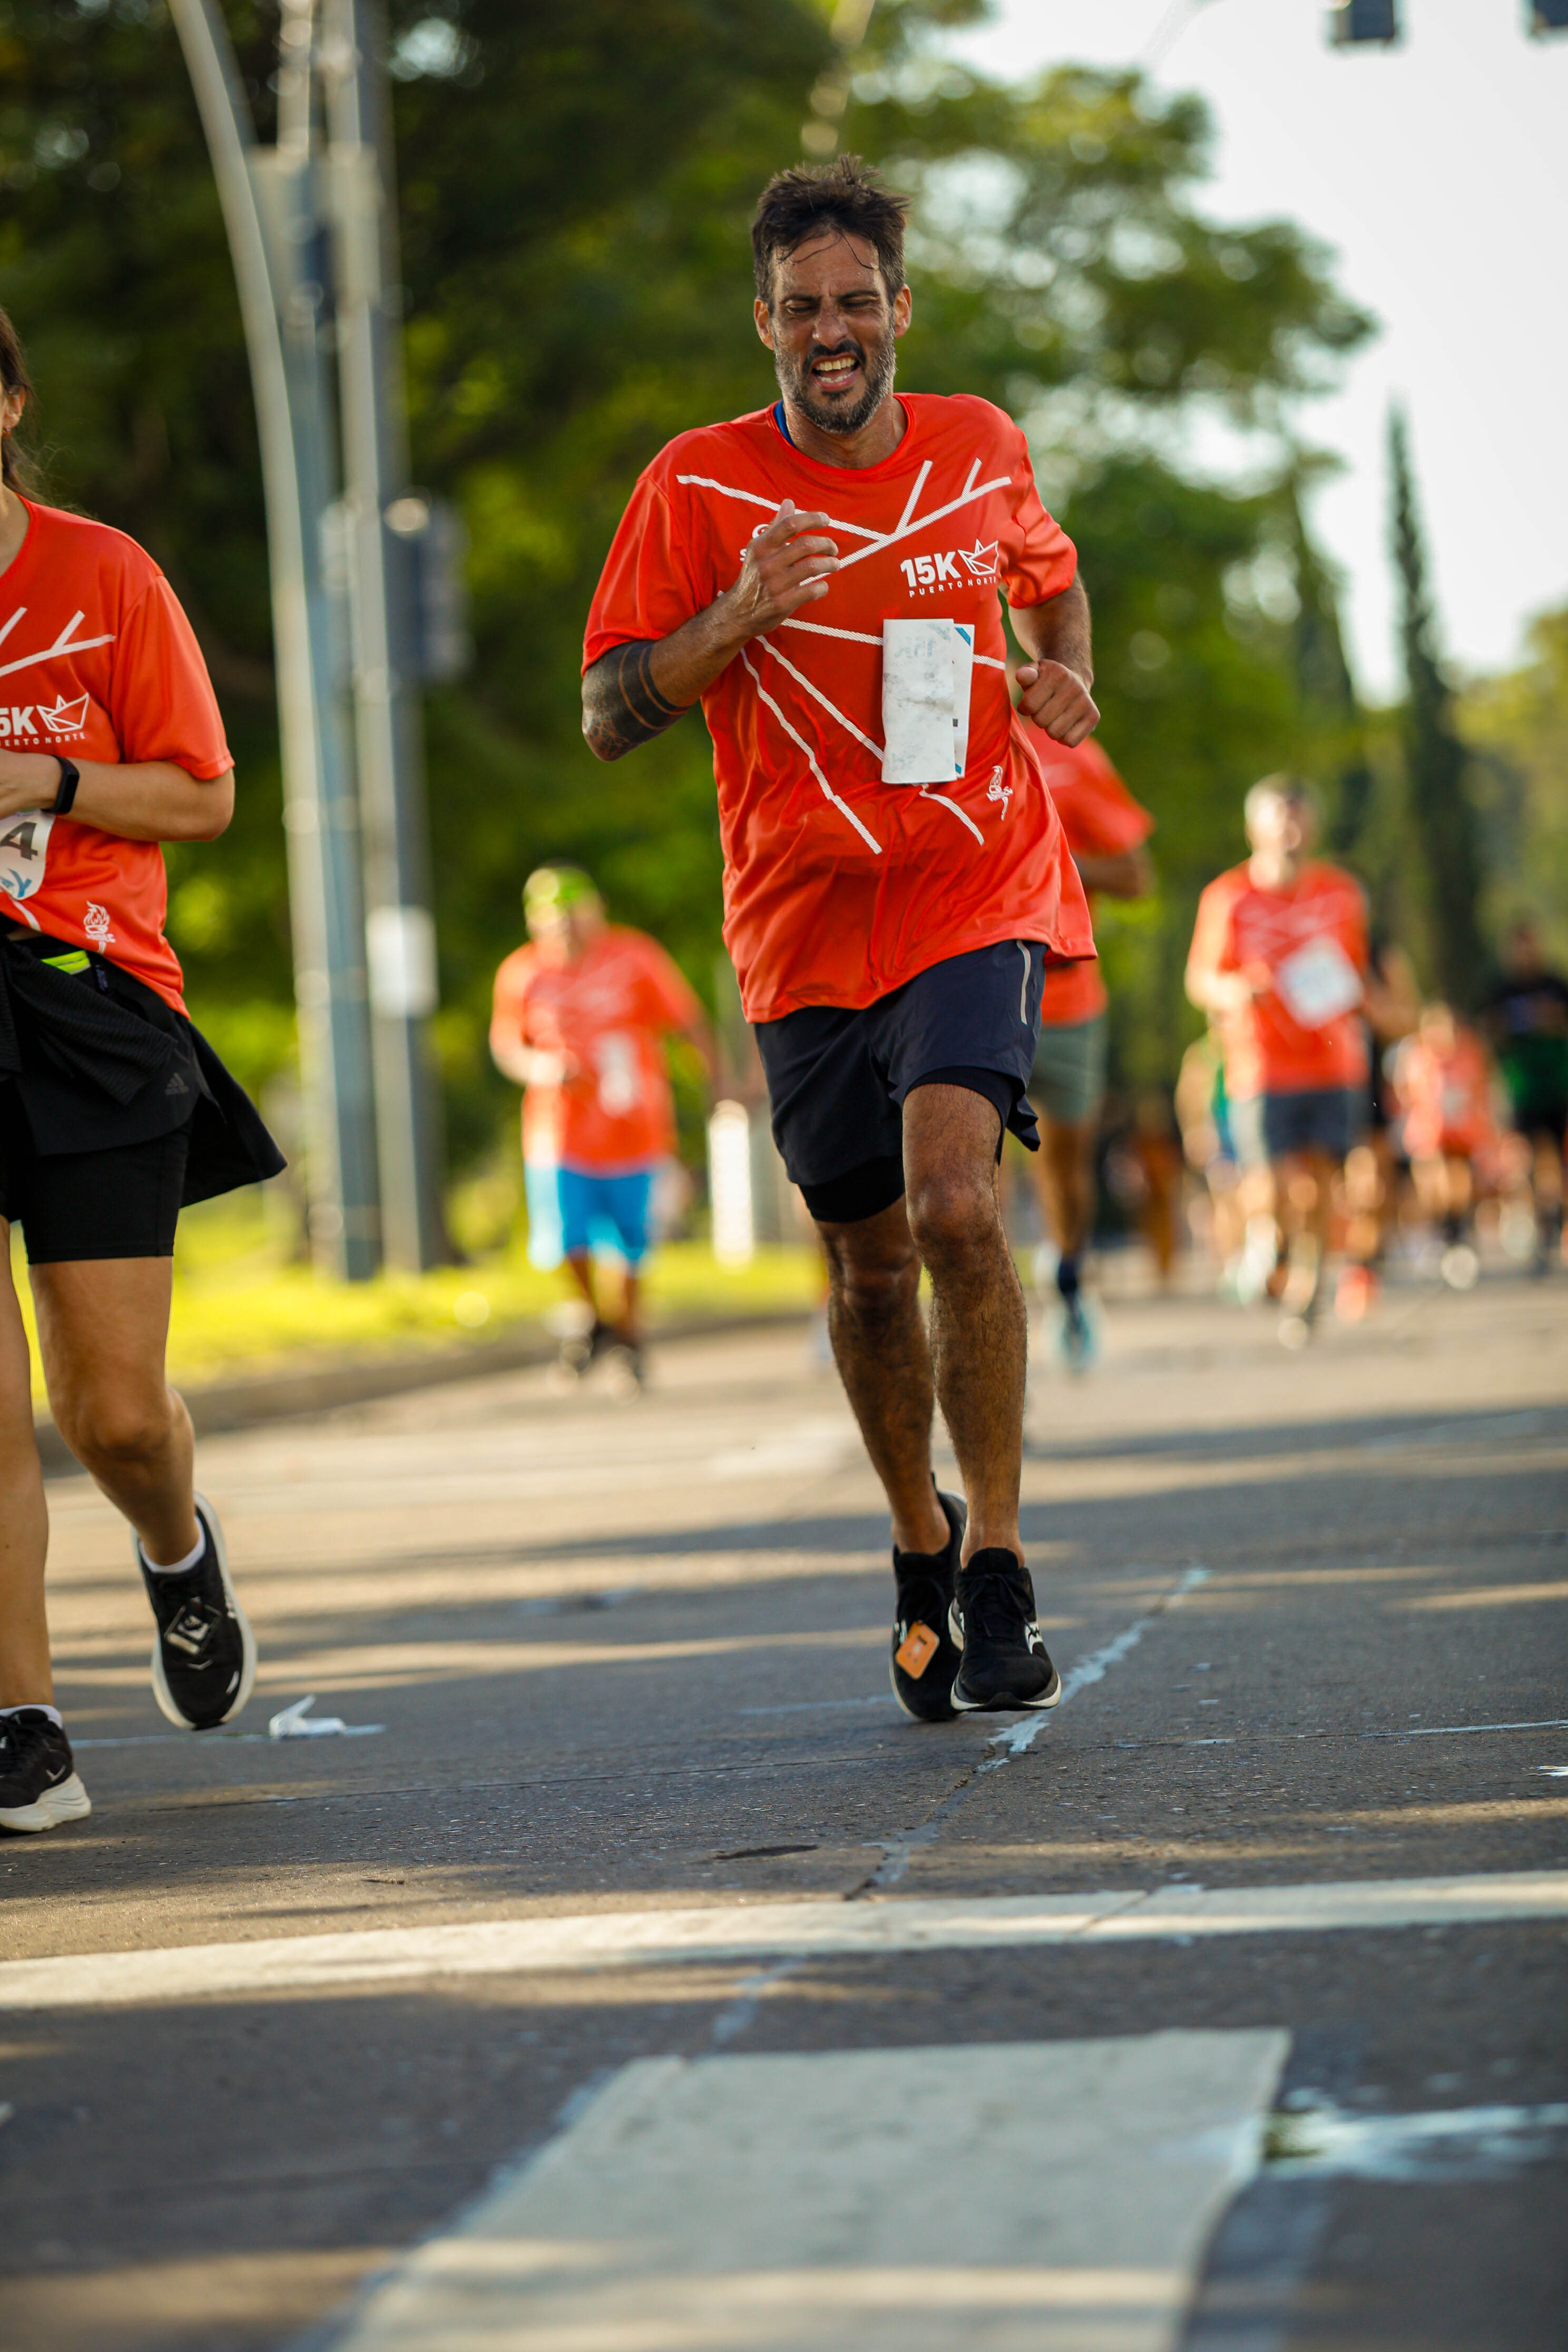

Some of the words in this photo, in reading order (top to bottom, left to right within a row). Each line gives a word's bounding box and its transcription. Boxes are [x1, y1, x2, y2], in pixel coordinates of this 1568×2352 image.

[900, 551, 962, 587] 15K
[909, 581, 963, 598] PUERTO
[967, 576, 997, 587] NORTE
[0, 737, 40, 747] ERTO
[45, 732, 85, 744] NORTE
